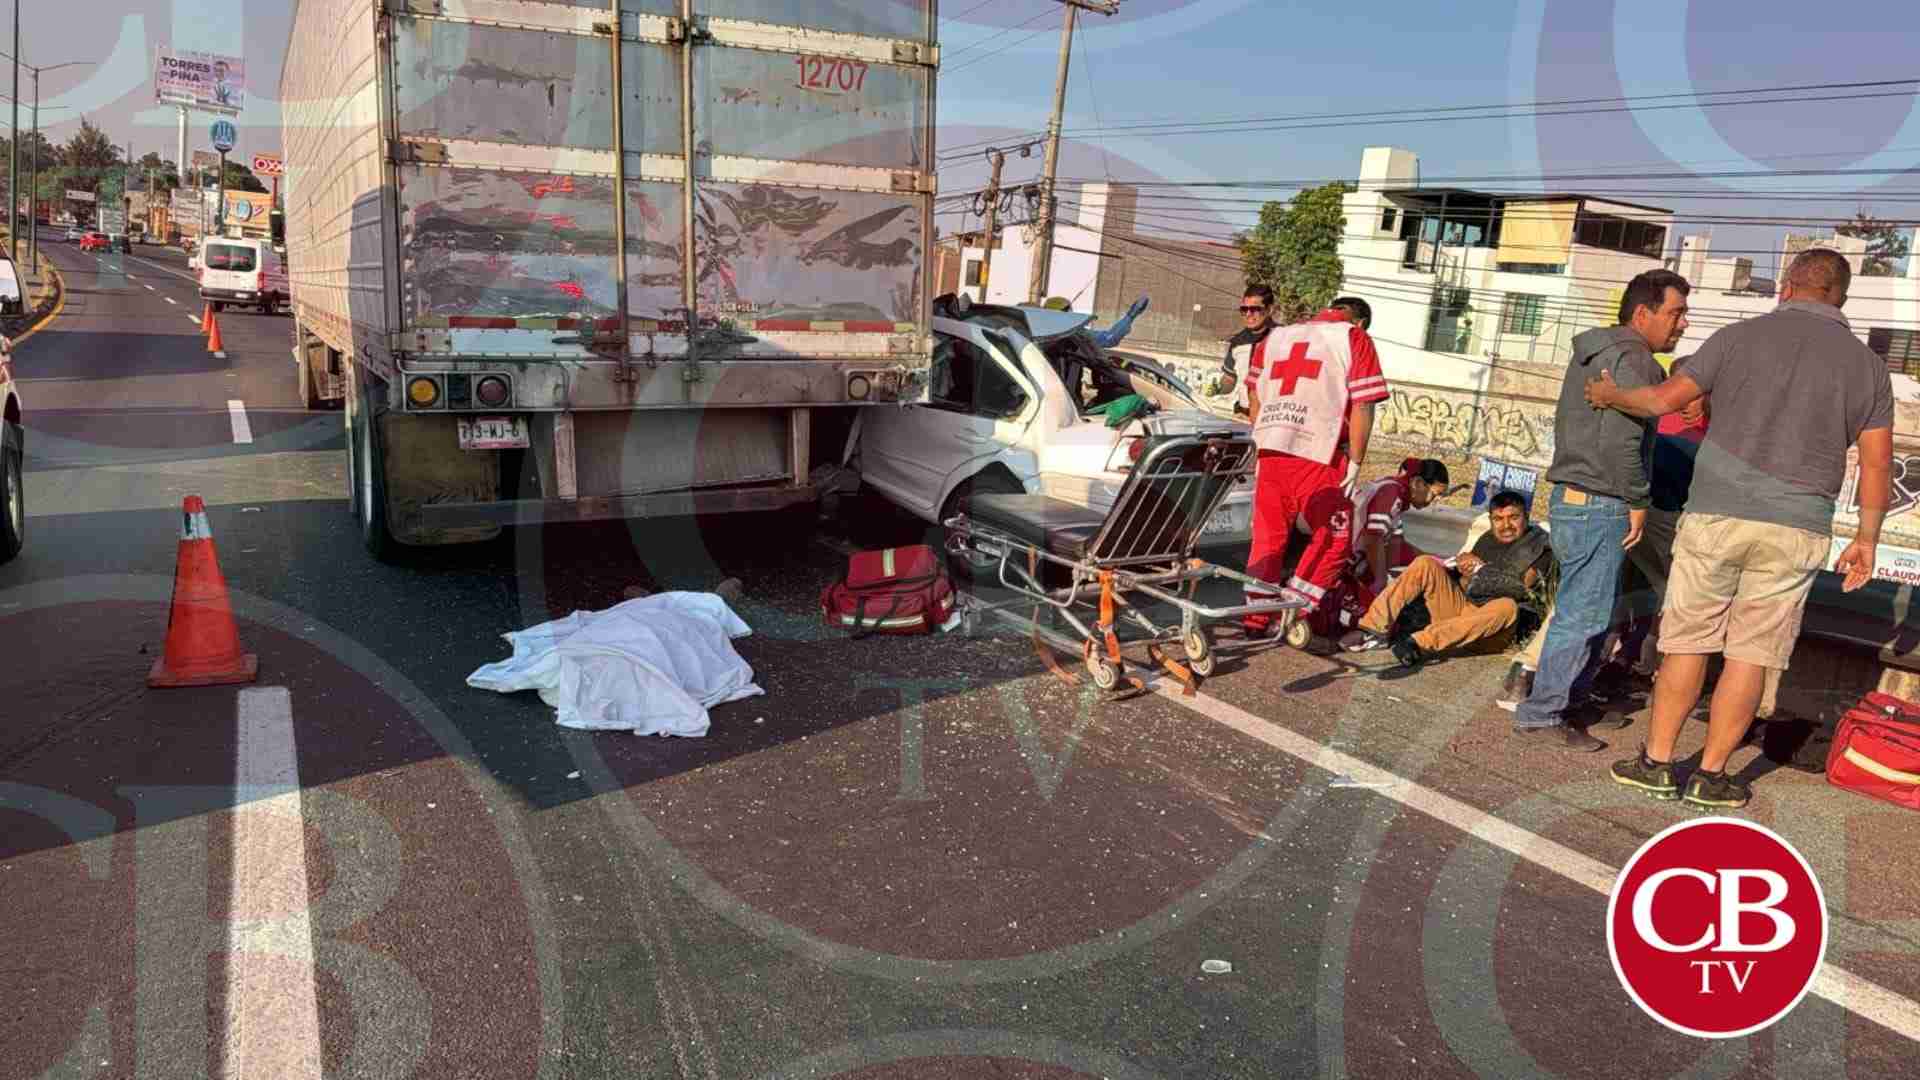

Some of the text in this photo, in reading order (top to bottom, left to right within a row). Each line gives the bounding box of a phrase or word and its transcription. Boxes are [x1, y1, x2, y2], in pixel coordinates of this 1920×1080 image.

[160, 56, 210, 73] TORRES
[794, 55, 869, 93] 12707
[255, 159, 286, 174] OXX
[1263, 402, 1309, 414] CRUZ ROJA
[1260, 413, 1306, 426] MEXICANA
